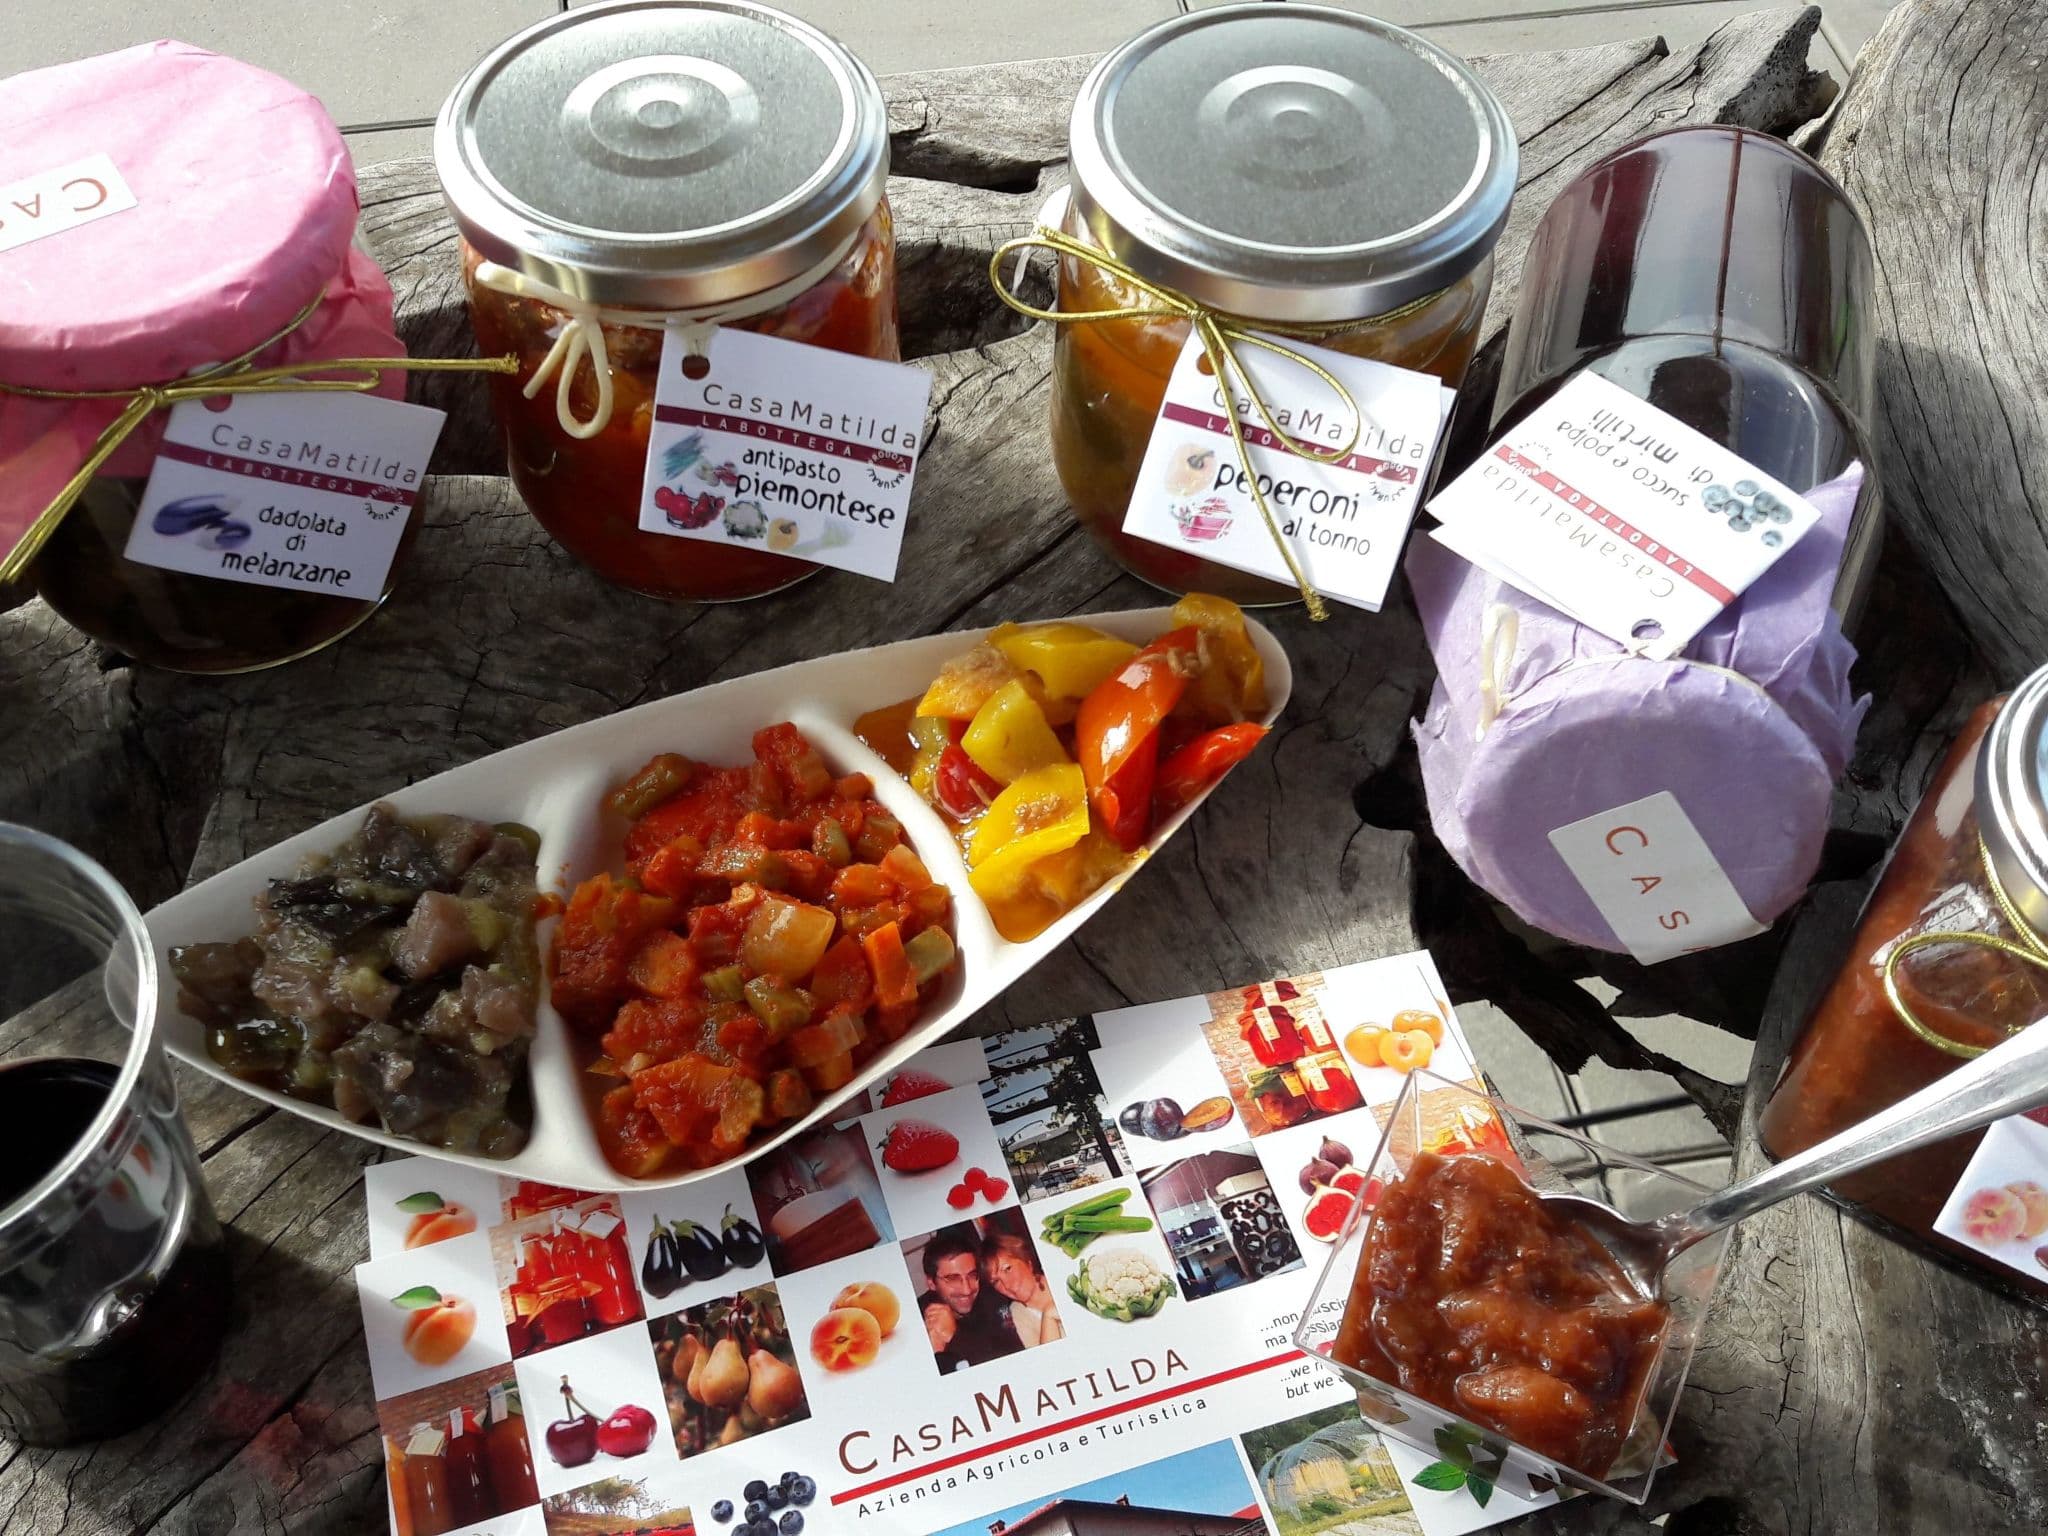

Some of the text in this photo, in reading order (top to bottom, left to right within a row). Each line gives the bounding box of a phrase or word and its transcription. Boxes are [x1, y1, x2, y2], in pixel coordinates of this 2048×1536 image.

[0, 177, 108, 230] CA
[702, 383, 917, 450] CasaMatilda
[1591, 407, 1680, 465] mirtilli
[211, 423, 418, 485] CasaMatilda
[741, 448, 841, 484] antipasto
[1556, 420, 1690, 508] succo e polpa
[1686, 465, 1714, 485] di
[734, 473, 896, 529] piemontese
[1213, 463, 1360, 521] peperoni
[257, 504, 347, 538] dadolata
[285, 534, 306, 553] di
[1281, 516, 1372, 556] al tonno
[1482, 463, 1675, 599] CasaMatilda
[219, 551, 353, 588] melanzane
[1605, 825, 1712, 953] CAS
[1265, 1333, 1288, 1349] ma
[1280, 1364, 1312, 1383] ...we
[1285, 1381, 1311, 1399] but
[1313, 1376, 1334, 1390] we
[857, 1396, 1208, 1519] Azienda Agricola e Turistica
